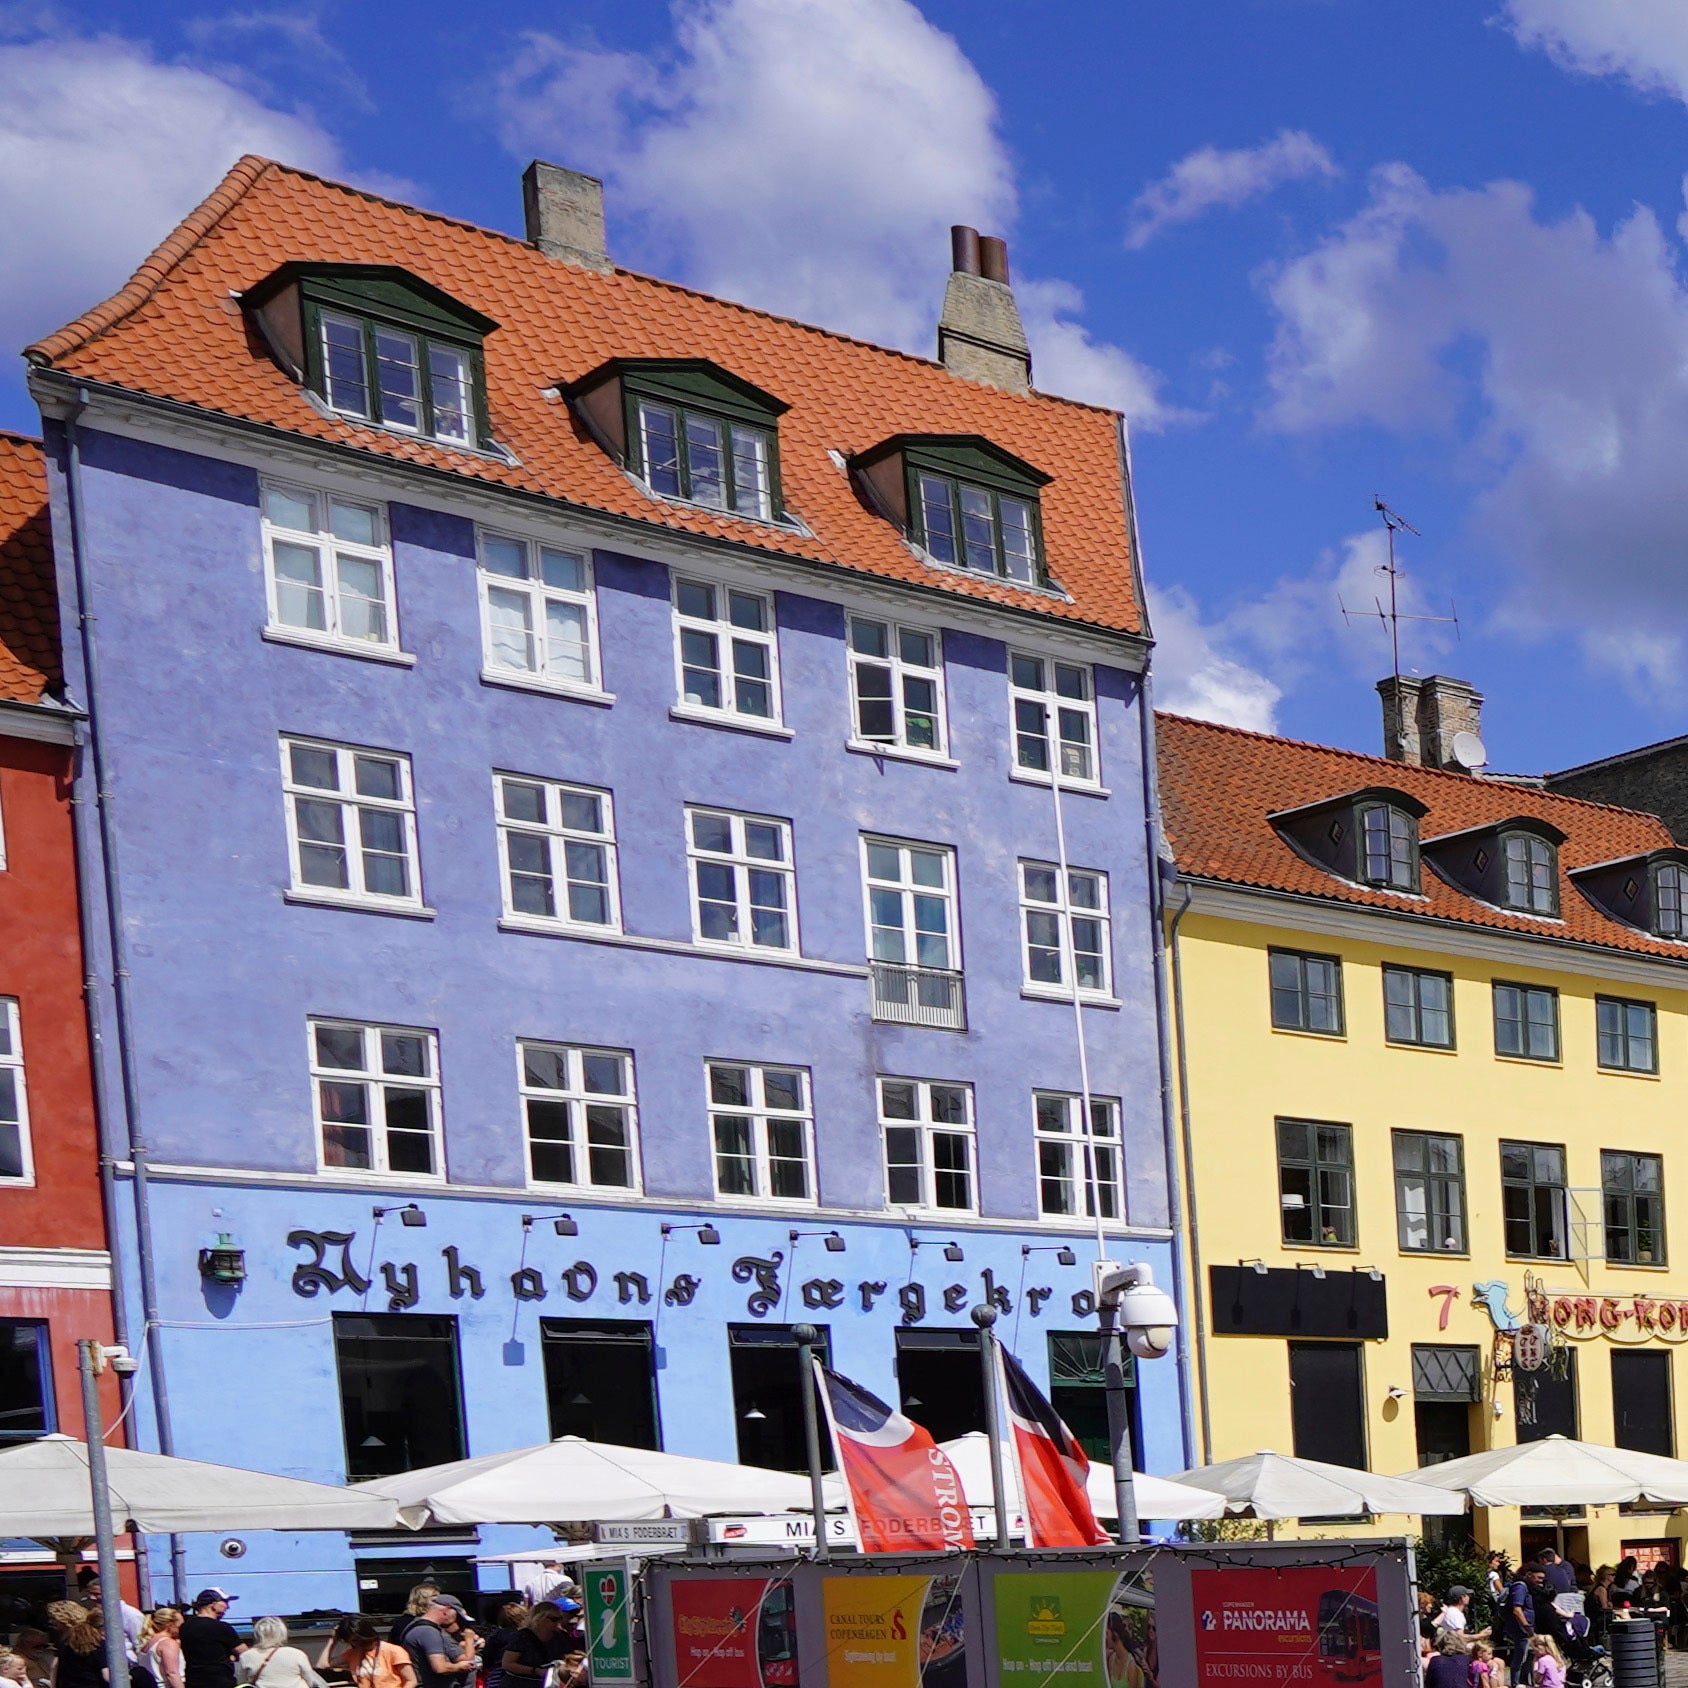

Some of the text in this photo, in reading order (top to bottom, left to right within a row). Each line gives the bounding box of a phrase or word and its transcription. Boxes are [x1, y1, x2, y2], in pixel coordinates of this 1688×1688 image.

[1428, 1285, 1461, 1331] 7
[831, 1615, 886, 1624] CANAL TOURS
[1223, 1611, 1311, 1630] PANORAMA
[831, 1629, 886, 1640] COPENHAGEN
[594, 1656, 630, 1671] TOURIST
[1206, 1664, 1313, 1678] EXCURSIONS BY BUS
